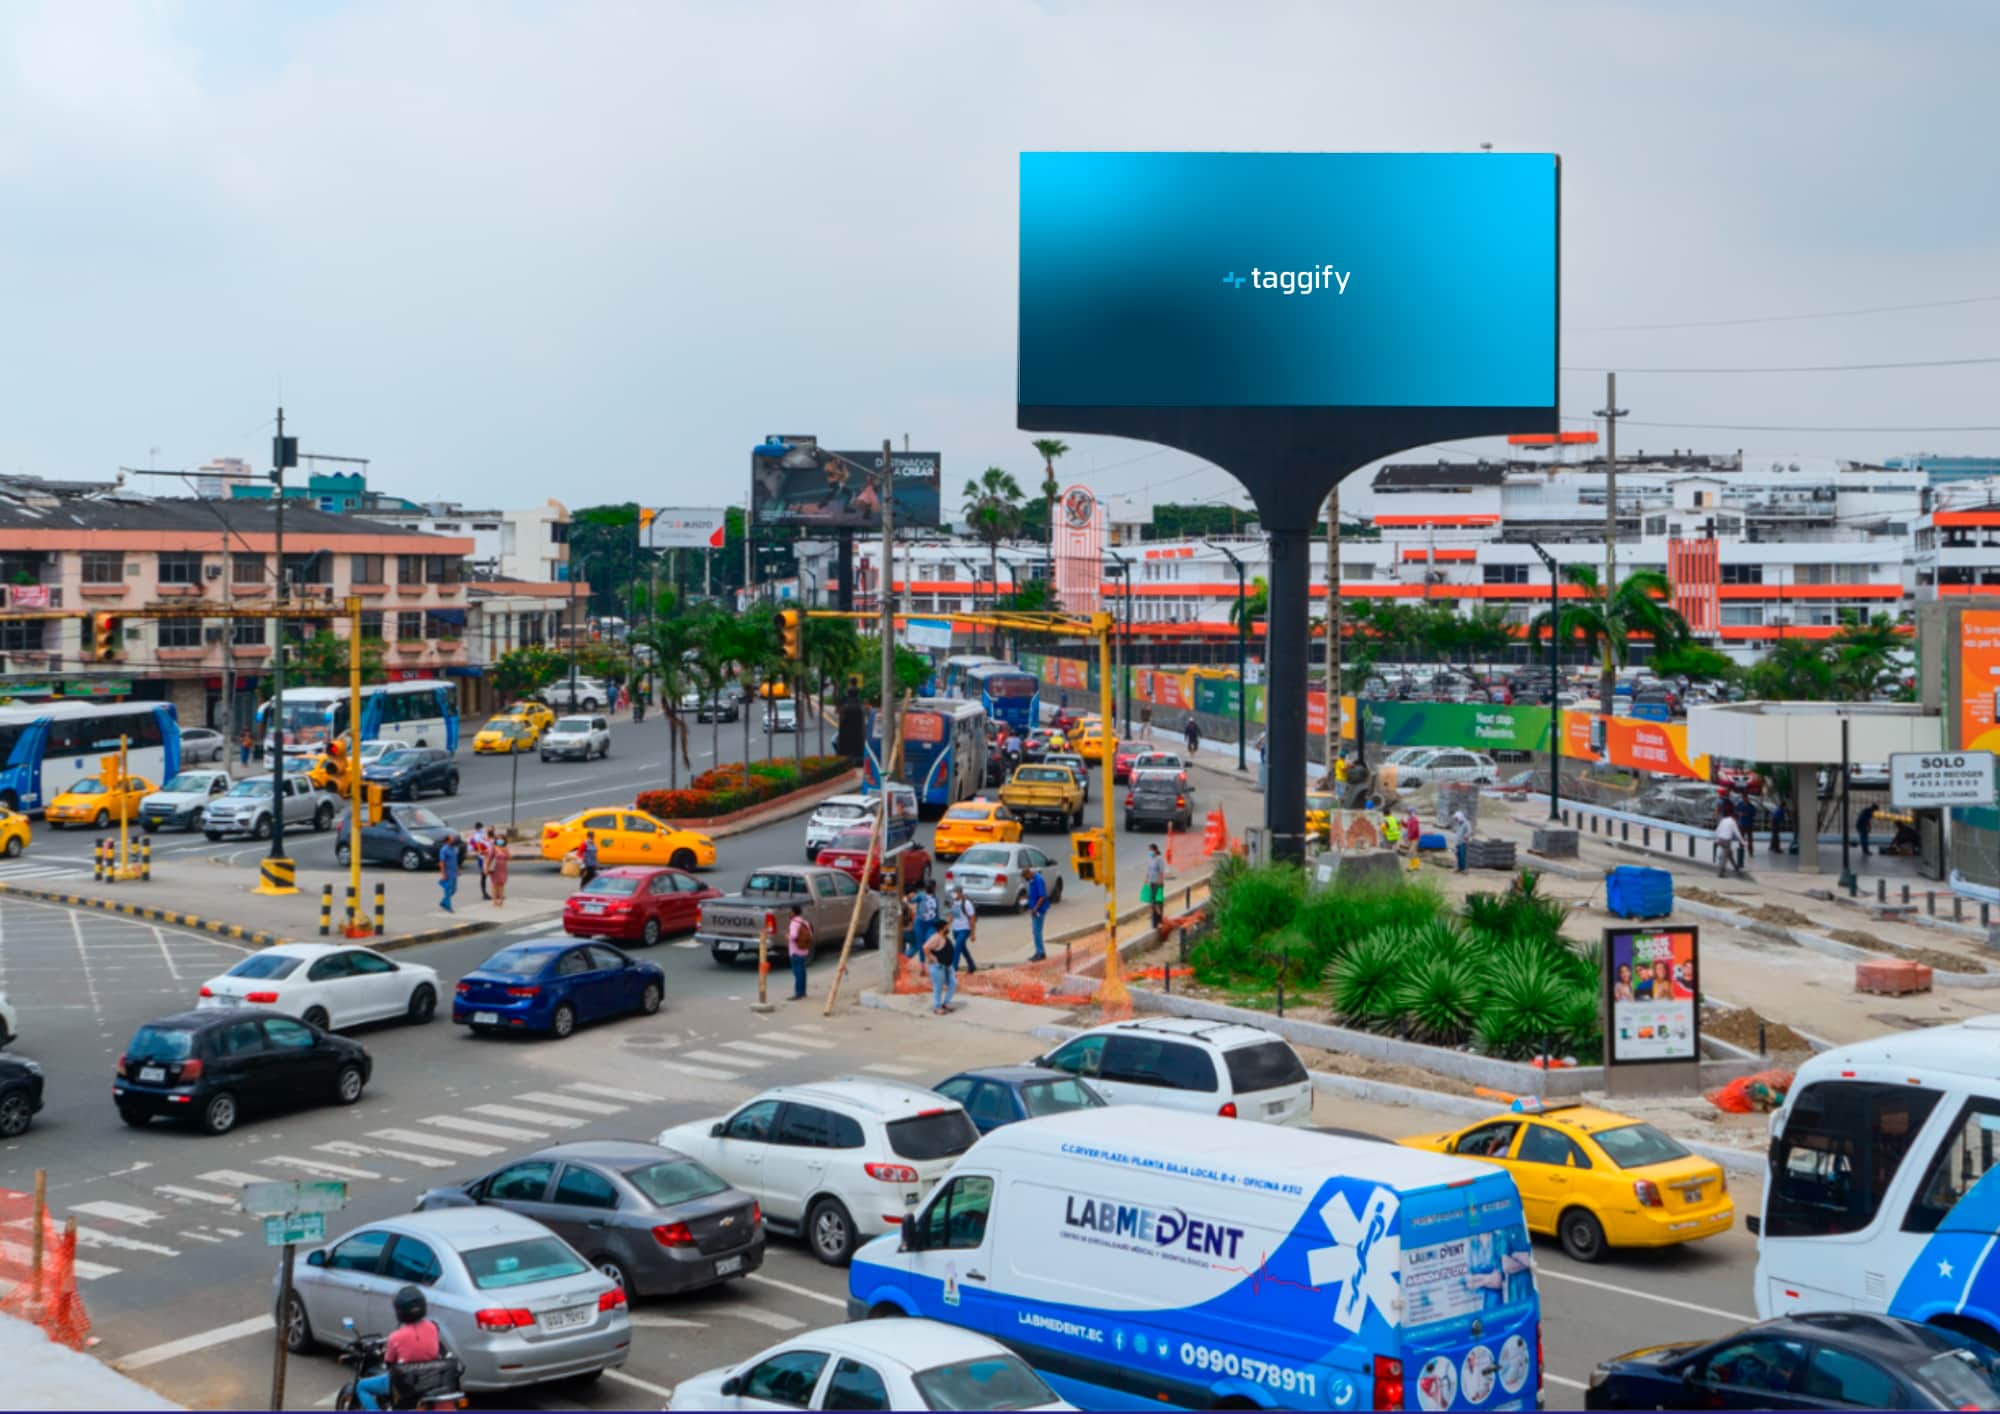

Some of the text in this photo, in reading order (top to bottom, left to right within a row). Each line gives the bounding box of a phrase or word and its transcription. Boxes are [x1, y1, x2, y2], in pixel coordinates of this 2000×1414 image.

[1251, 264, 1351, 295] taggify
[1921, 757, 1965, 769] SOLO
[711, 915, 756, 928] TOYOTA
[1131, 1156, 1164, 1171] PLANTA
[1166, 1163, 1189, 1175] BAJA
[1190, 1166, 1219, 1181] LOCAL
[1243, 1176, 1280, 1191] OFICINA
[1065, 1195, 1244, 1260] LABMEDENT
[1018, 1311, 1104, 1343] LABMEDENT.EC
[1180, 1342, 1316, 1397] 0990578911
